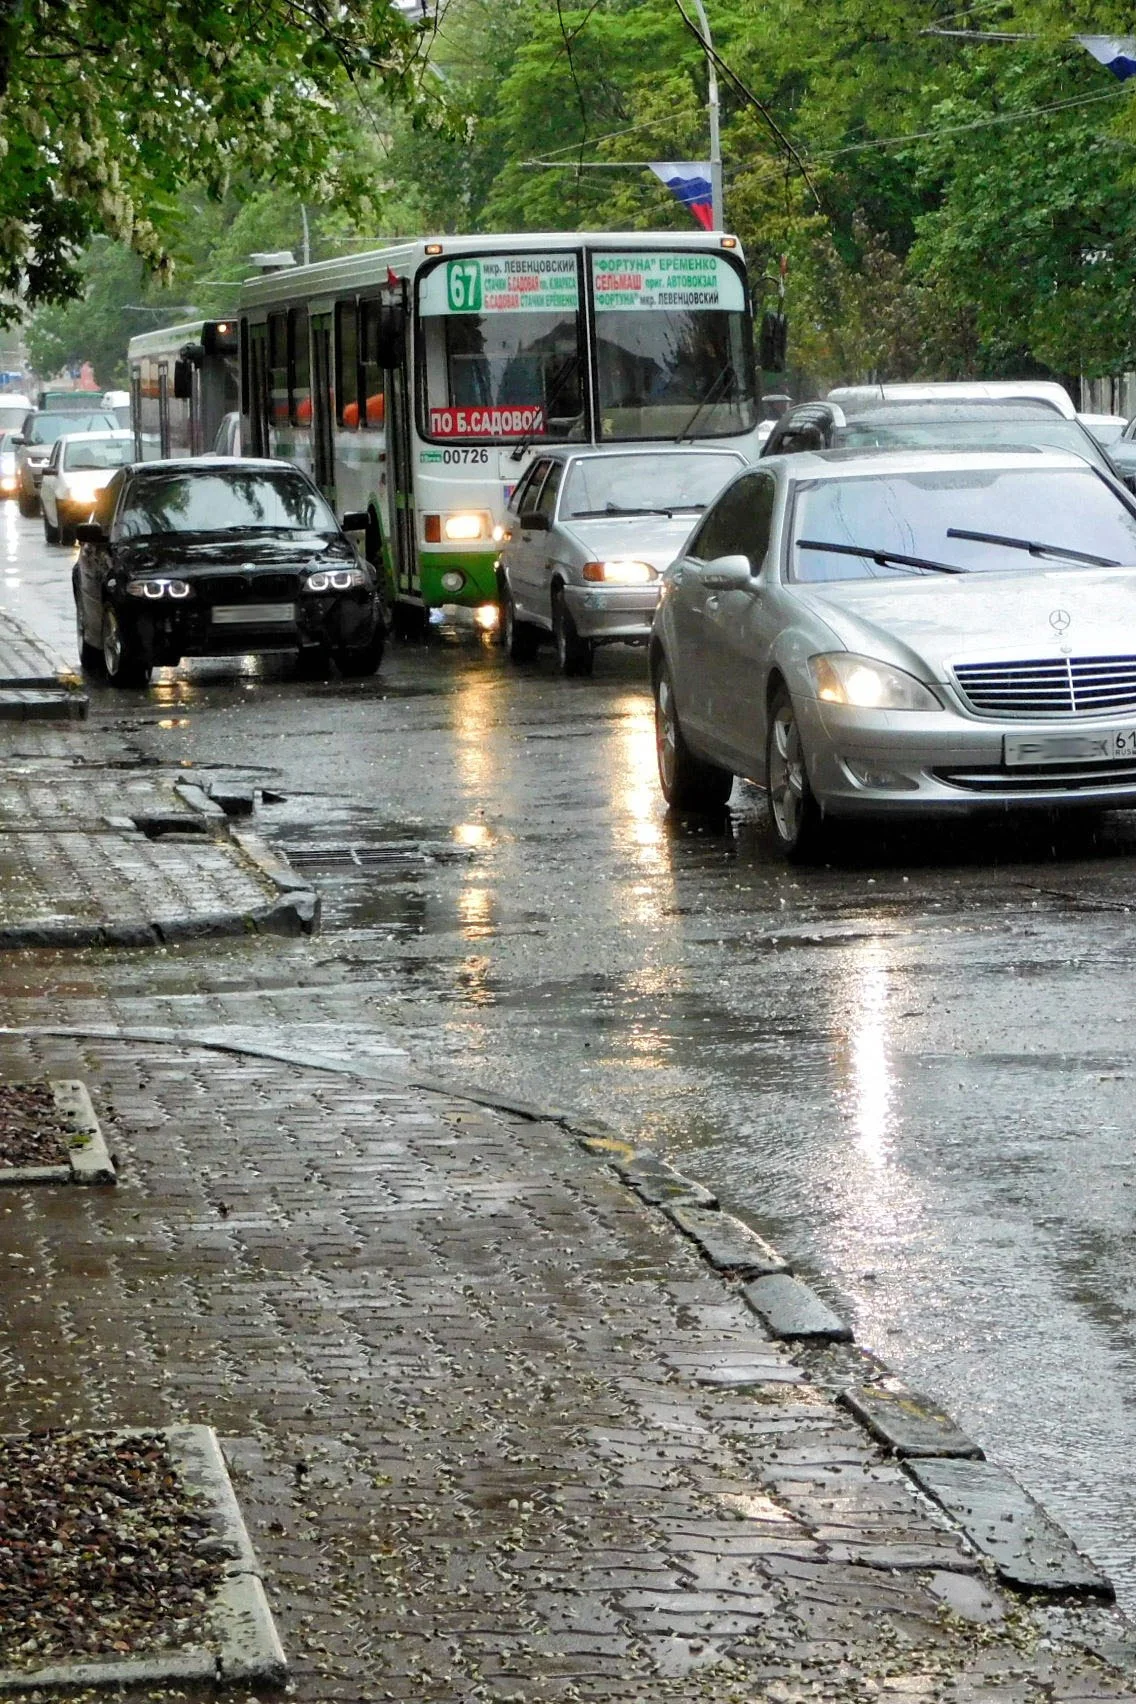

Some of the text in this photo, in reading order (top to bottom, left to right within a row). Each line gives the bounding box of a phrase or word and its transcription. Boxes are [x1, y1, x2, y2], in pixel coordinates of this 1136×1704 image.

[484, 259, 575, 276] мкр. ЛЕВЕНЦОВСКИЙ
[450, 264, 478, 308] 67
[595, 274, 642, 290] СЕЛЬМАШ
[667, 275, 717, 288] АВТОВОКЗАЛ
[640, 296, 657, 307] мкр.
[658, 289, 719, 306] ЛЕВЕНЦОВСКИЙ
[431, 406, 544, 436] ПО Б.САДОВОЙ
[443, 449, 489, 464] 00726
[1115, 731, 1136, 749] 61
[1115, 748, 1132, 756] RUS
